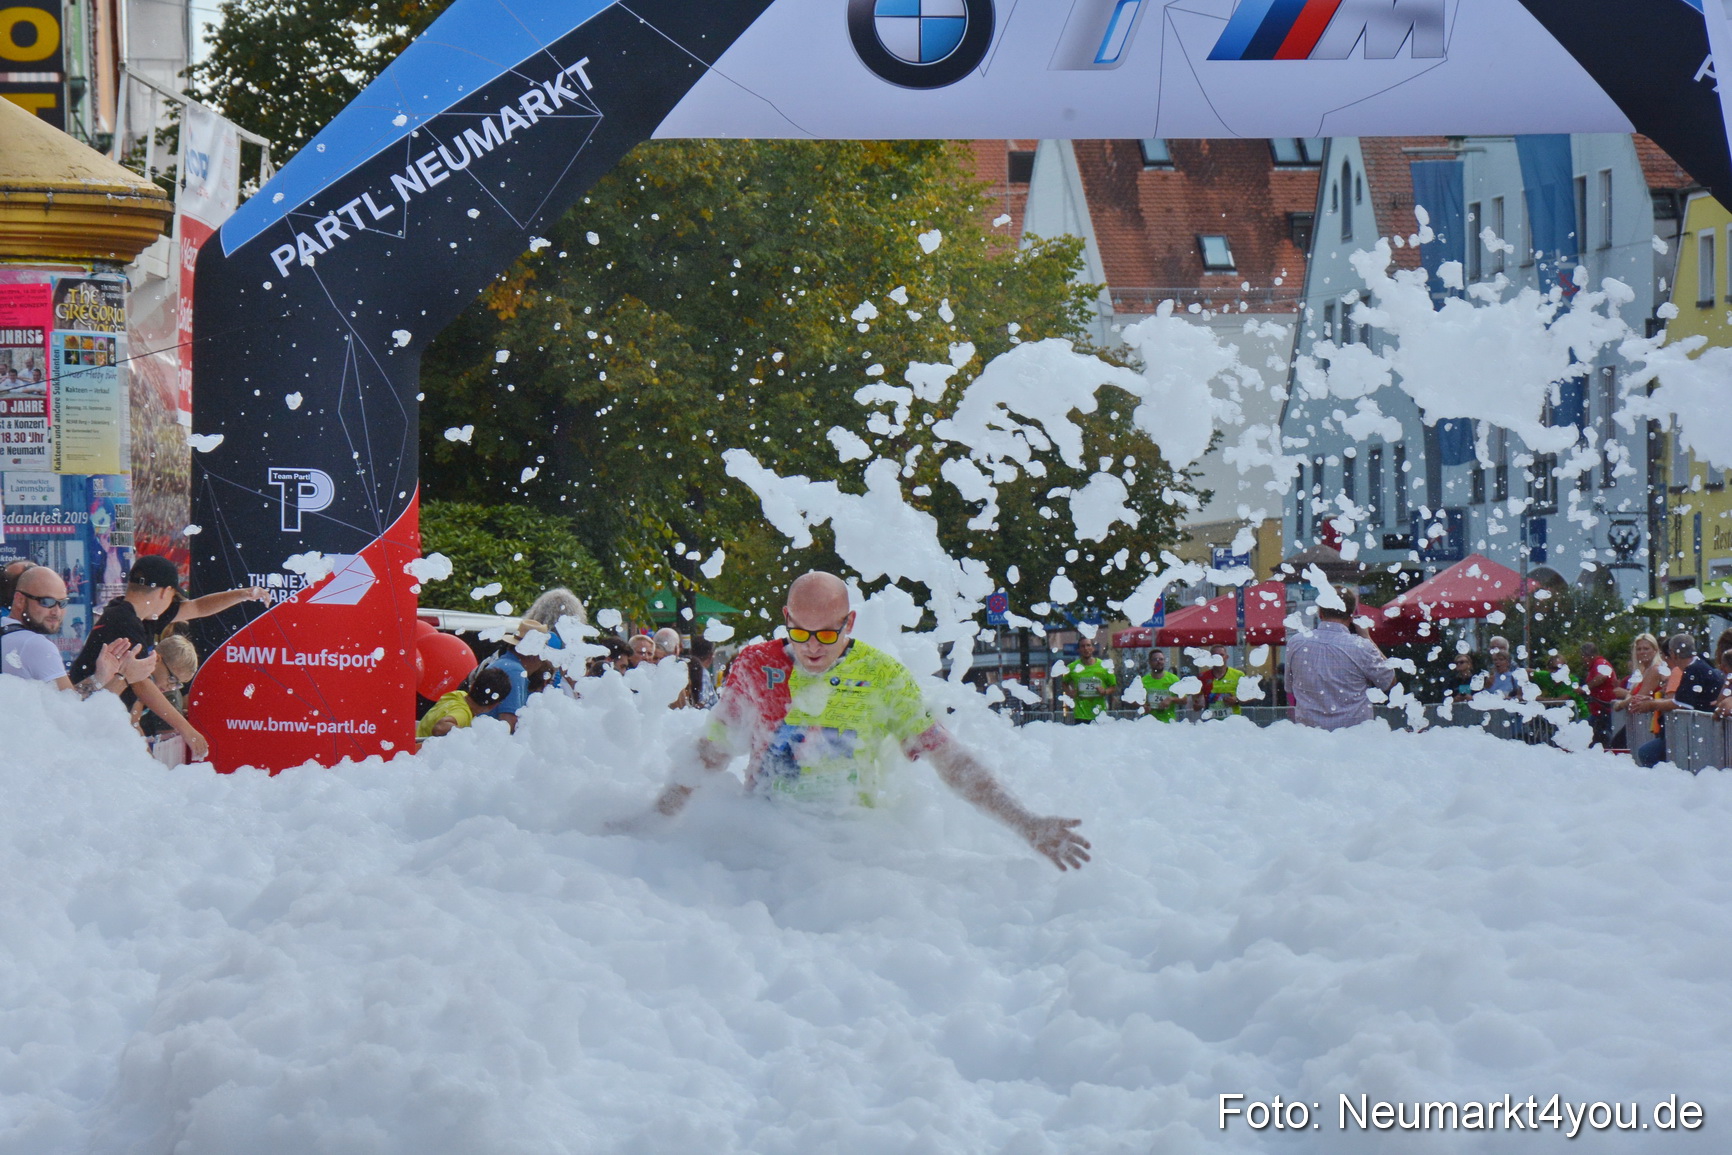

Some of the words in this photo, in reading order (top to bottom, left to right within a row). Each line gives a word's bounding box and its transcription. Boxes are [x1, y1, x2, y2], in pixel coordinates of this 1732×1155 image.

[270, 192, 395, 278] PARTL
[390, 56, 594, 203] NEUMARKT
[52, 349, 61, 395] Sukkulenten
[11, 399, 44, 413] JAHRE
[52, 398, 61, 422] andere
[14, 419, 44, 430] Konzert
[1, 431, 27, 444] 18.30
[53, 425, 61, 438] und
[7, 445, 46, 456] Neumarkt
[53, 440, 62, 471] Kakteen
[273, 472, 293, 480] Team
[10, 485, 55, 493] Lammsbräu
[63, 511, 89, 524] 2019
[226, 645, 276, 665] BMW
[281, 647, 377, 670] Laufsport
[226, 717, 377, 736] www.bmw-partl.de
